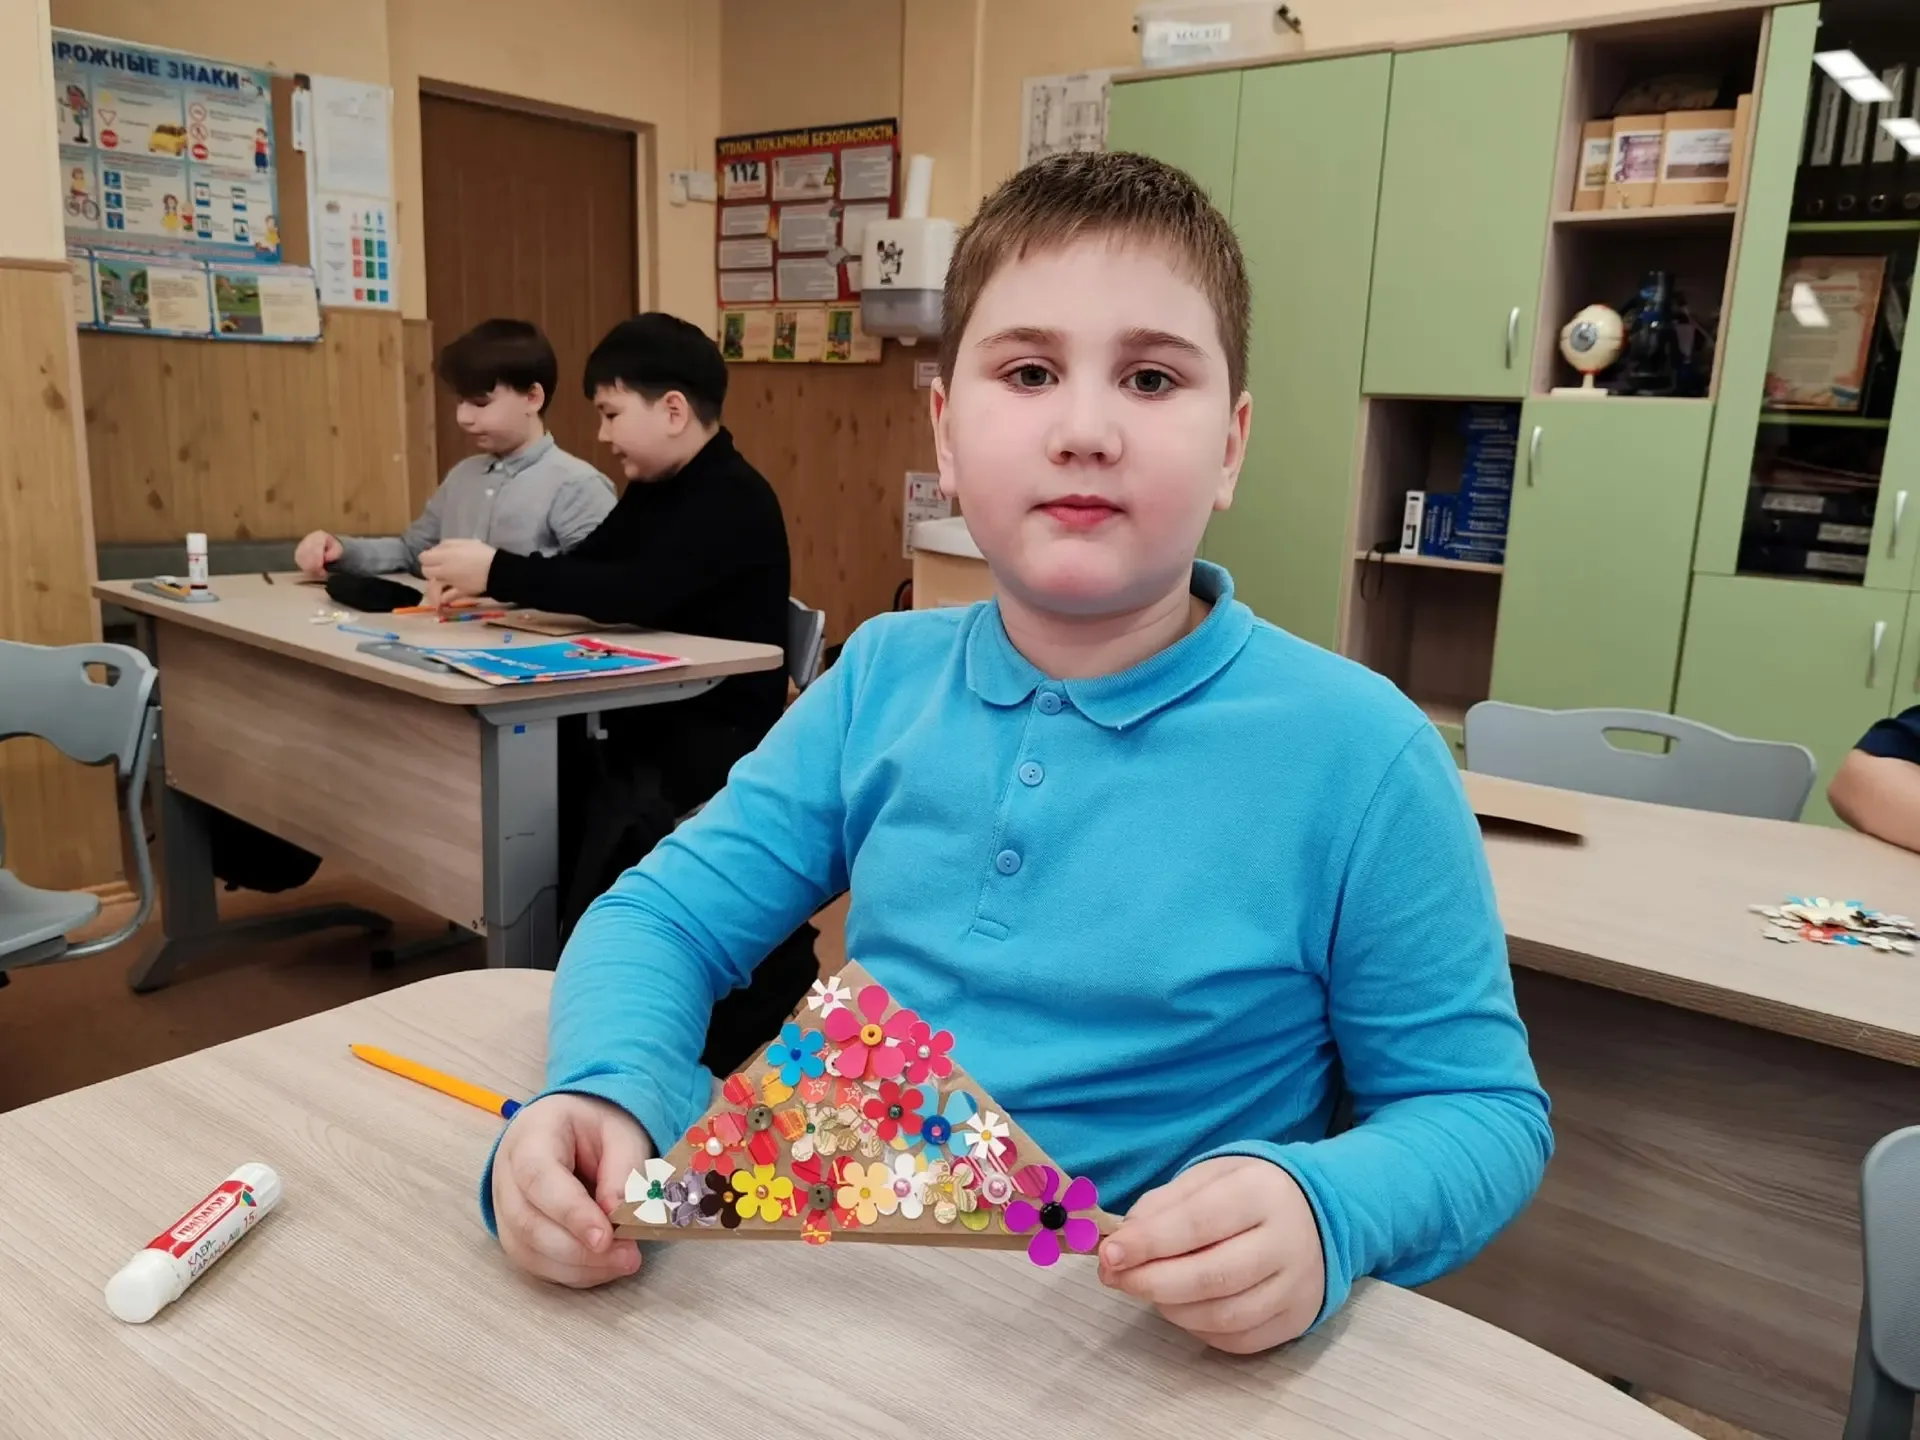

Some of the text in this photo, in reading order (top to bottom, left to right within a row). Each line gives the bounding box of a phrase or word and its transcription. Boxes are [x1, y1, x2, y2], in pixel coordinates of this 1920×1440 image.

[166, 58, 240, 90] ЗНАКИ
[720, 124, 893, 156] УГОЛОК ПОЖАРНОЙ БЕЗОПАСНОСТИ
[730, 160, 760, 183] 112
